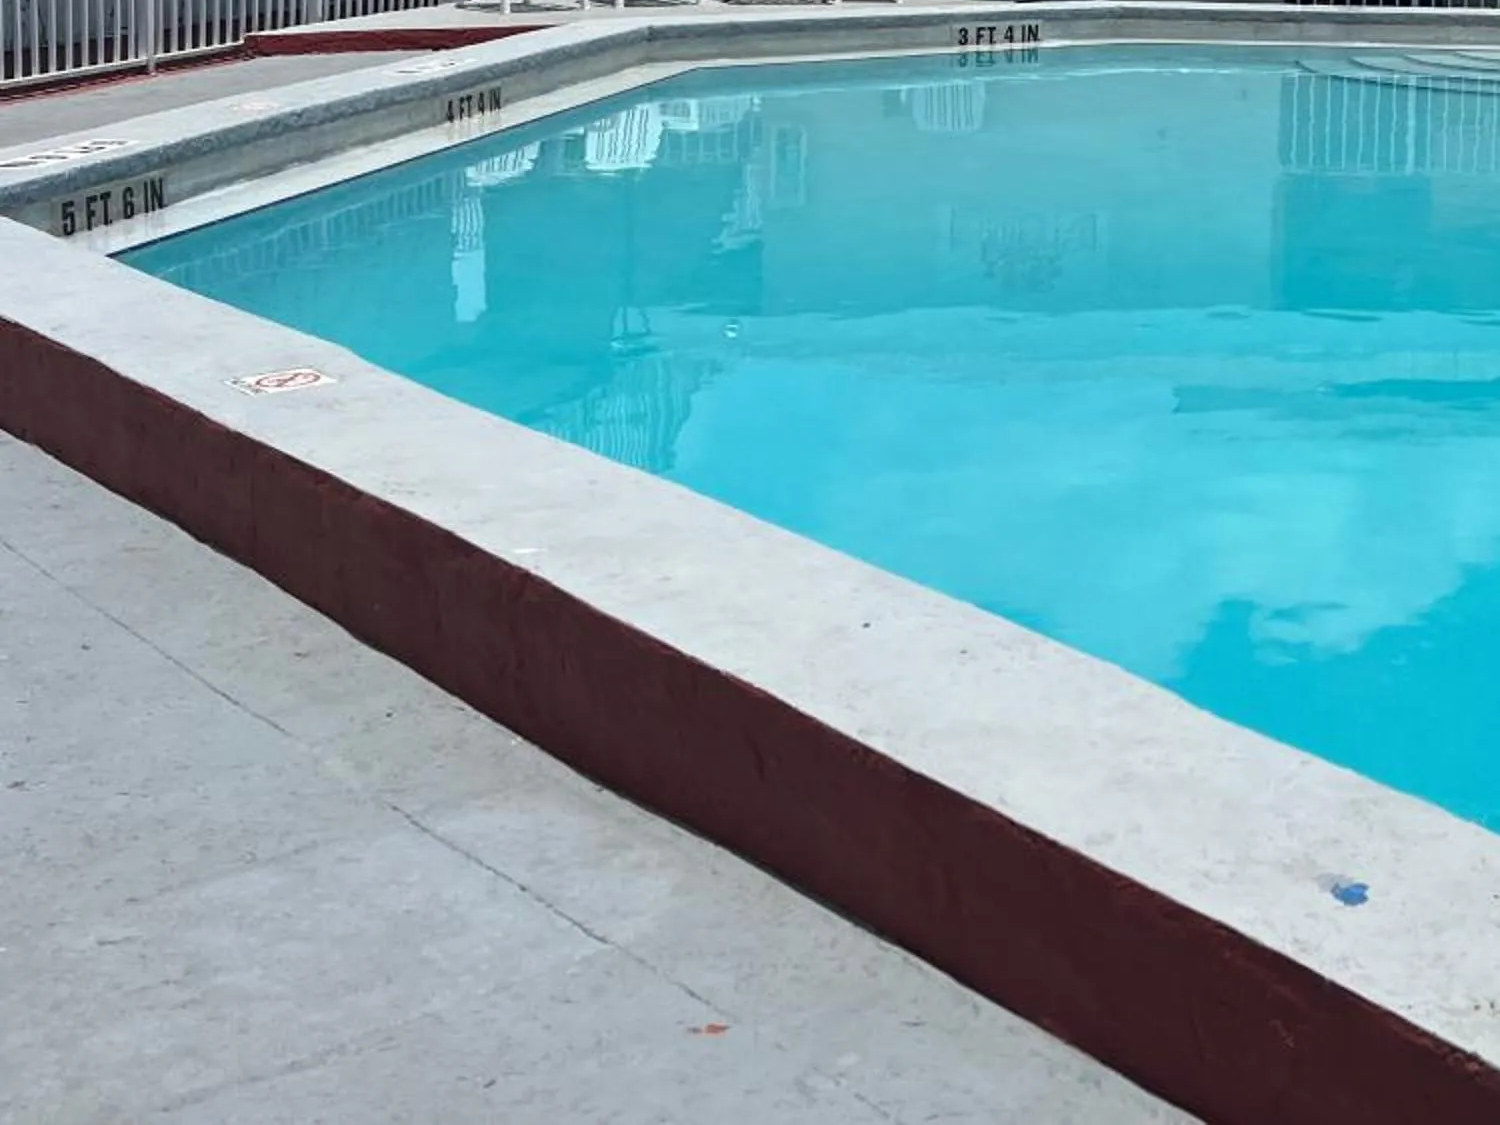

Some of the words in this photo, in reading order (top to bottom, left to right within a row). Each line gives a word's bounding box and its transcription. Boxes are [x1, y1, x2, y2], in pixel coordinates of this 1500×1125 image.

[958, 27, 969, 46] 3
[1003, 24, 1015, 43] 4
[60, 200, 76, 236] 5
[122, 186, 136, 220] 6
